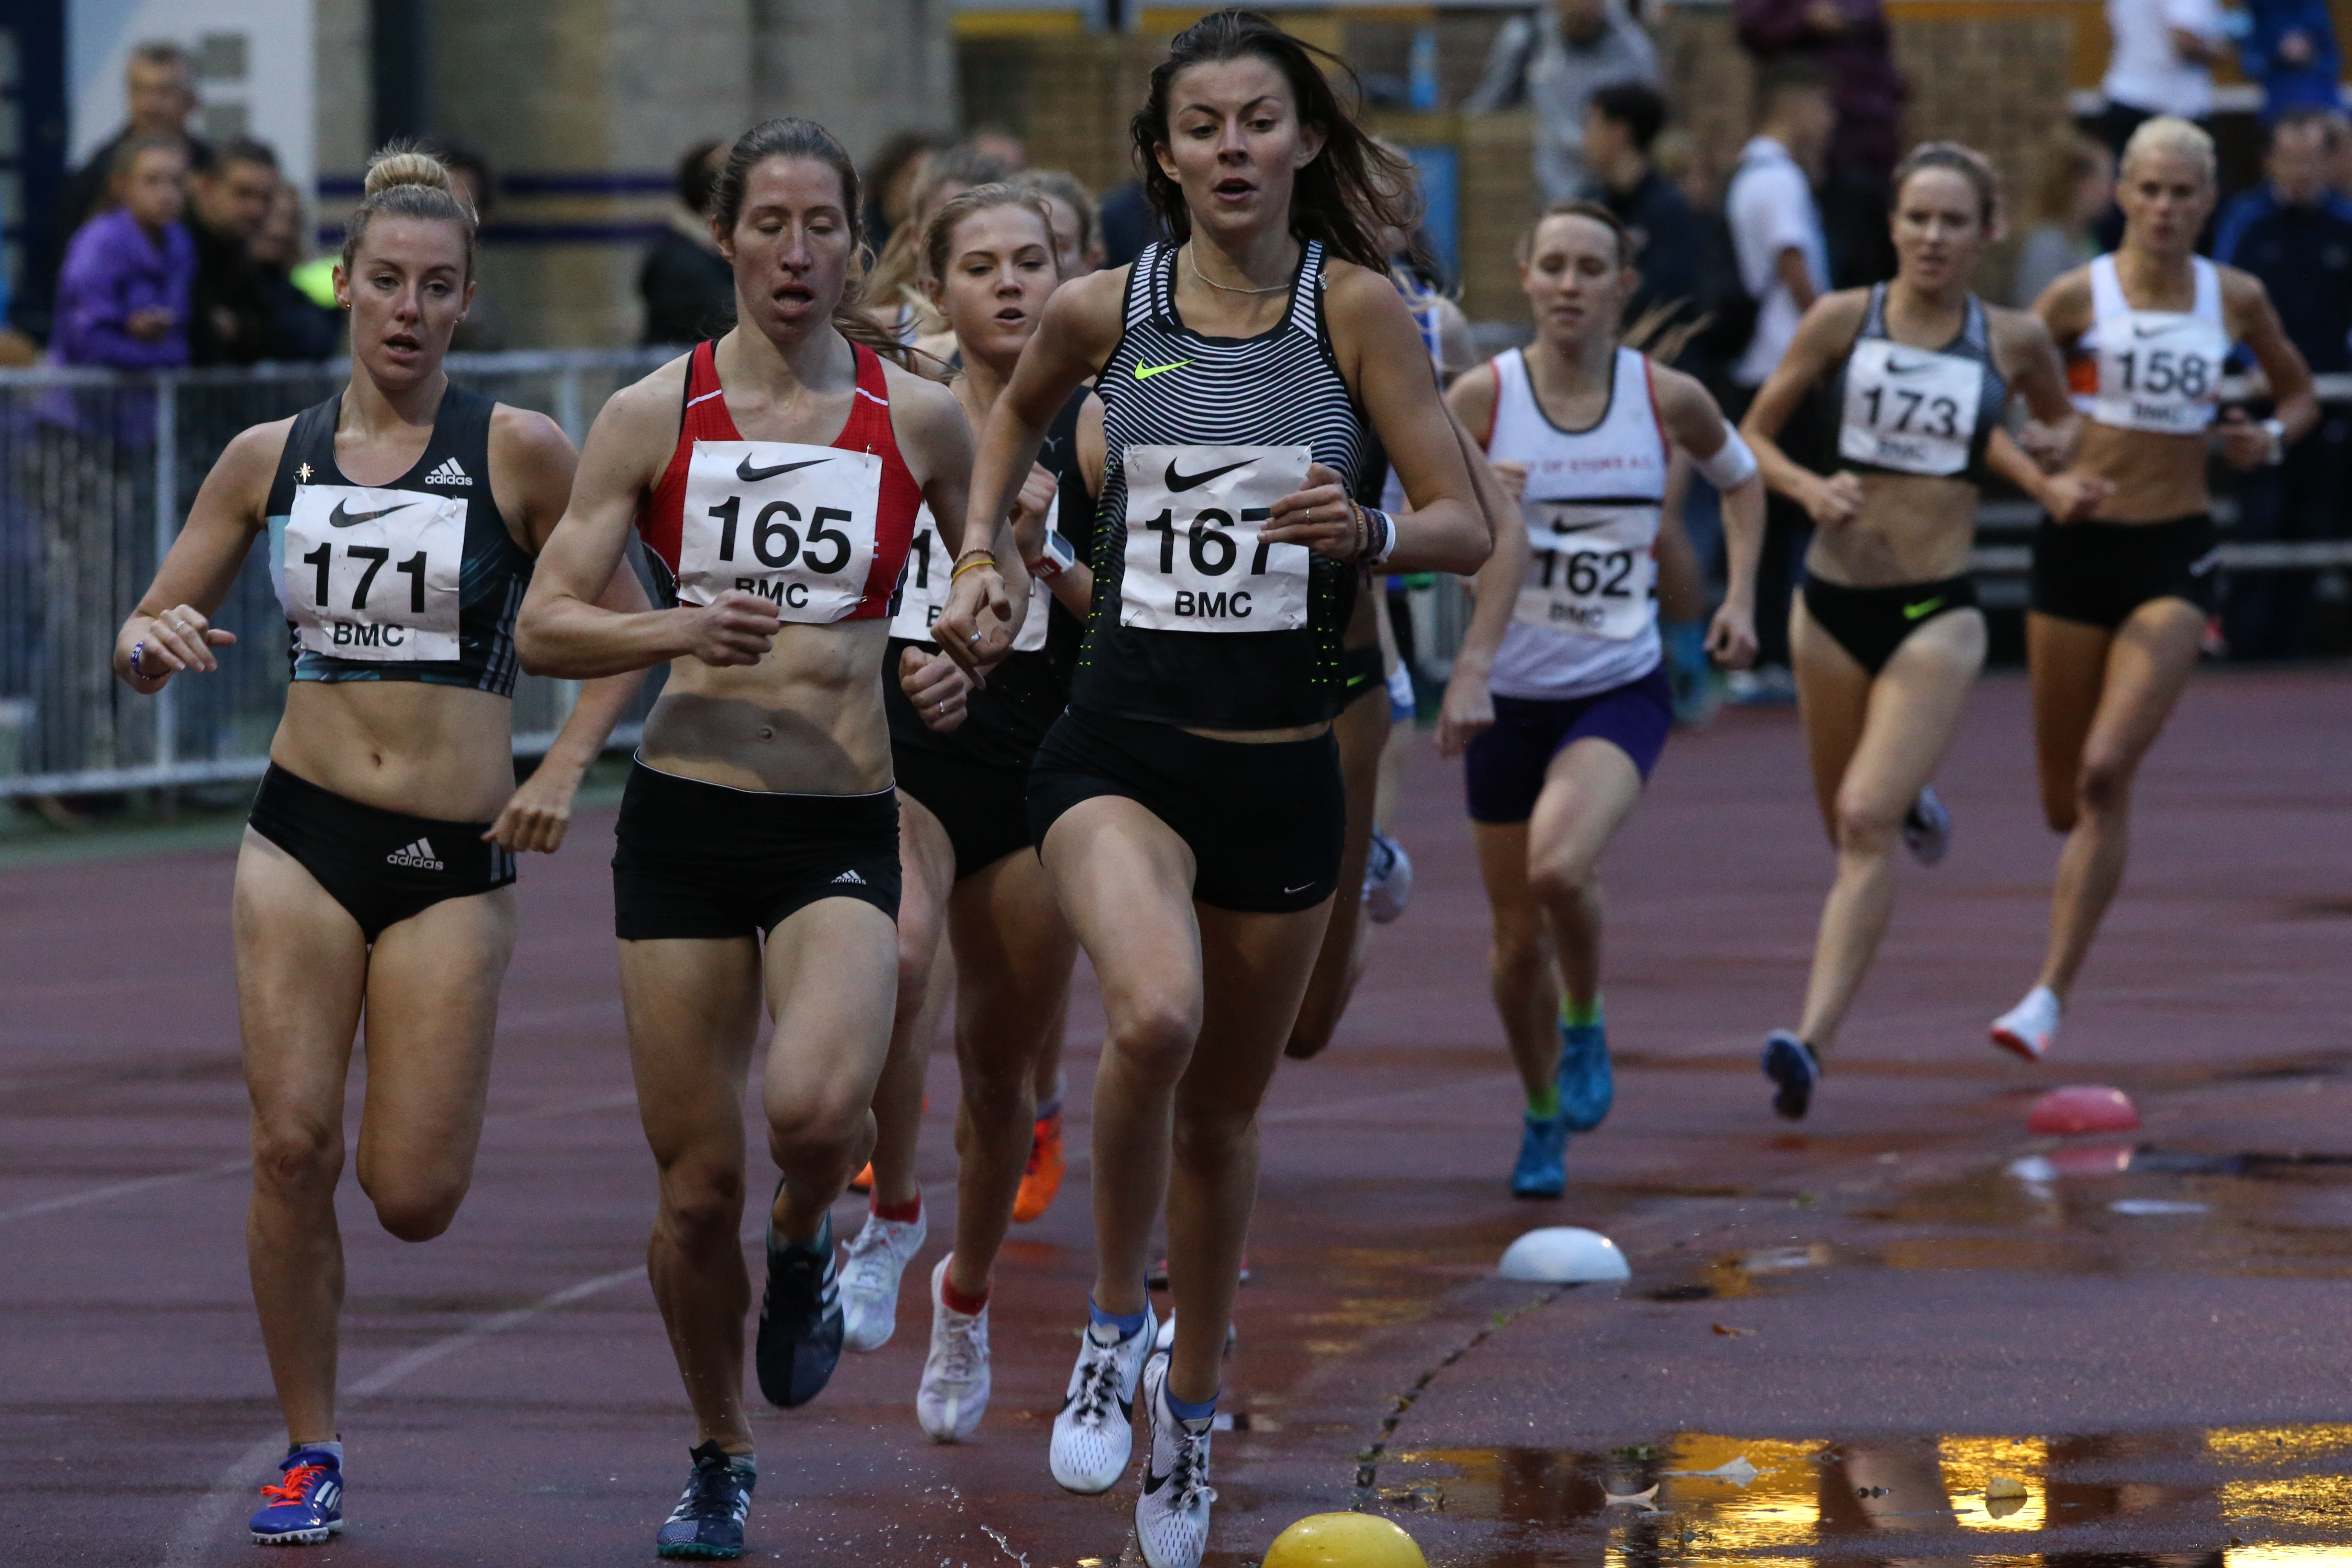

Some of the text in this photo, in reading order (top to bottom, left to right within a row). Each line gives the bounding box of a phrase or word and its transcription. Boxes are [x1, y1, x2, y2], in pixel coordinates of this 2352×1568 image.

[2116, 349, 2206, 397] 158
[1862, 387, 1960, 439] 173
[425, 474, 473, 485] adidas
[708, 495, 852, 574] 165
[1146, 508, 1271, 576] 167
[303, 542, 427, 613] 171
[1533, 548, 1632, 597] 162
[1175, 591, 1252, 618] BMC
[333, 622, 404, 647] BMC
[387, 854, 444, 870] adidas
